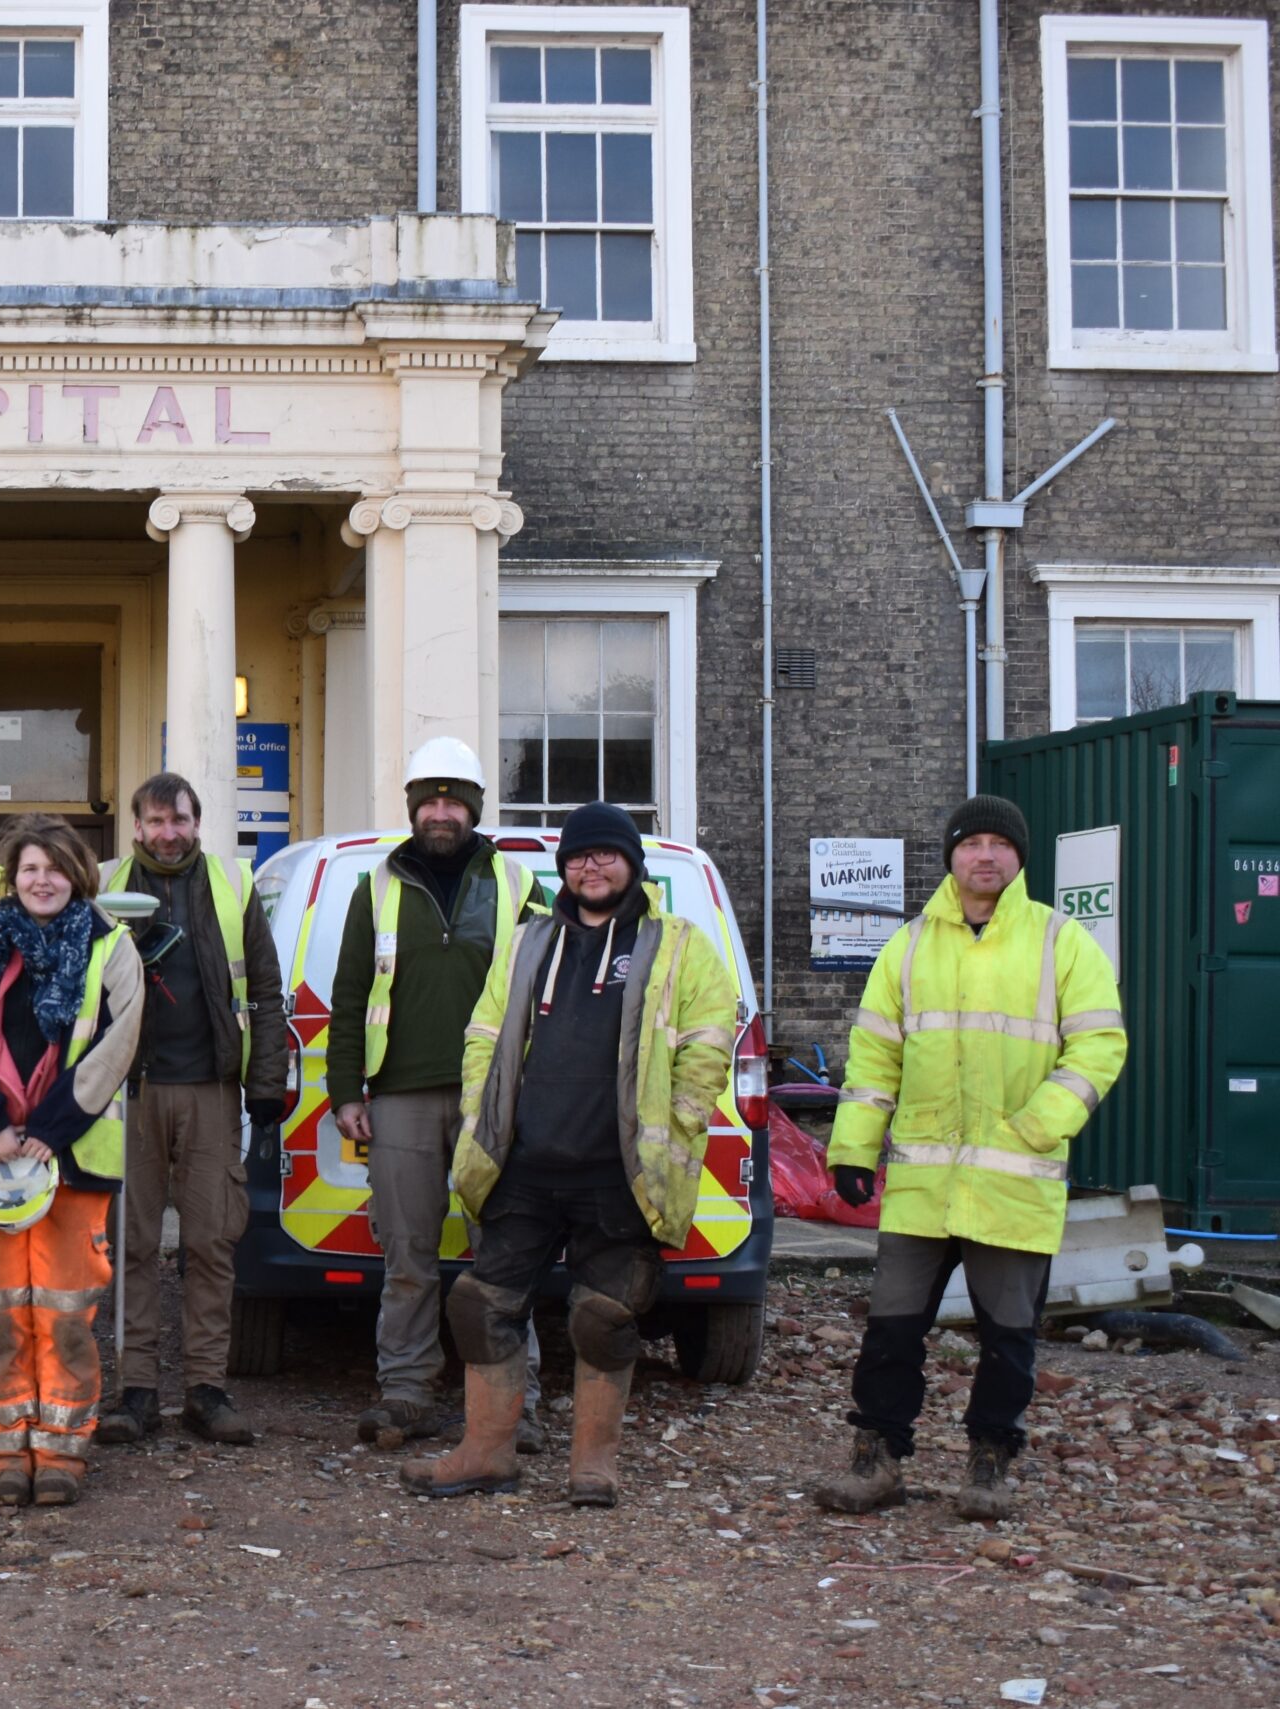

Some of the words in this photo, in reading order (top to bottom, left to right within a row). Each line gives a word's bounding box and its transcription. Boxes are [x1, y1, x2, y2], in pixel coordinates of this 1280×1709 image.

[236, 743, 256, 751] neral
[259, 742, 286, 752] Office
[831, 848, 872, 857] Guardians
[1234, 859, 1279, 872] 061636
[820, 864, 893, 888] WARNING
[1062, 888, 1110, 916] SRC
[1081, 921, 1098, 931] OUP
